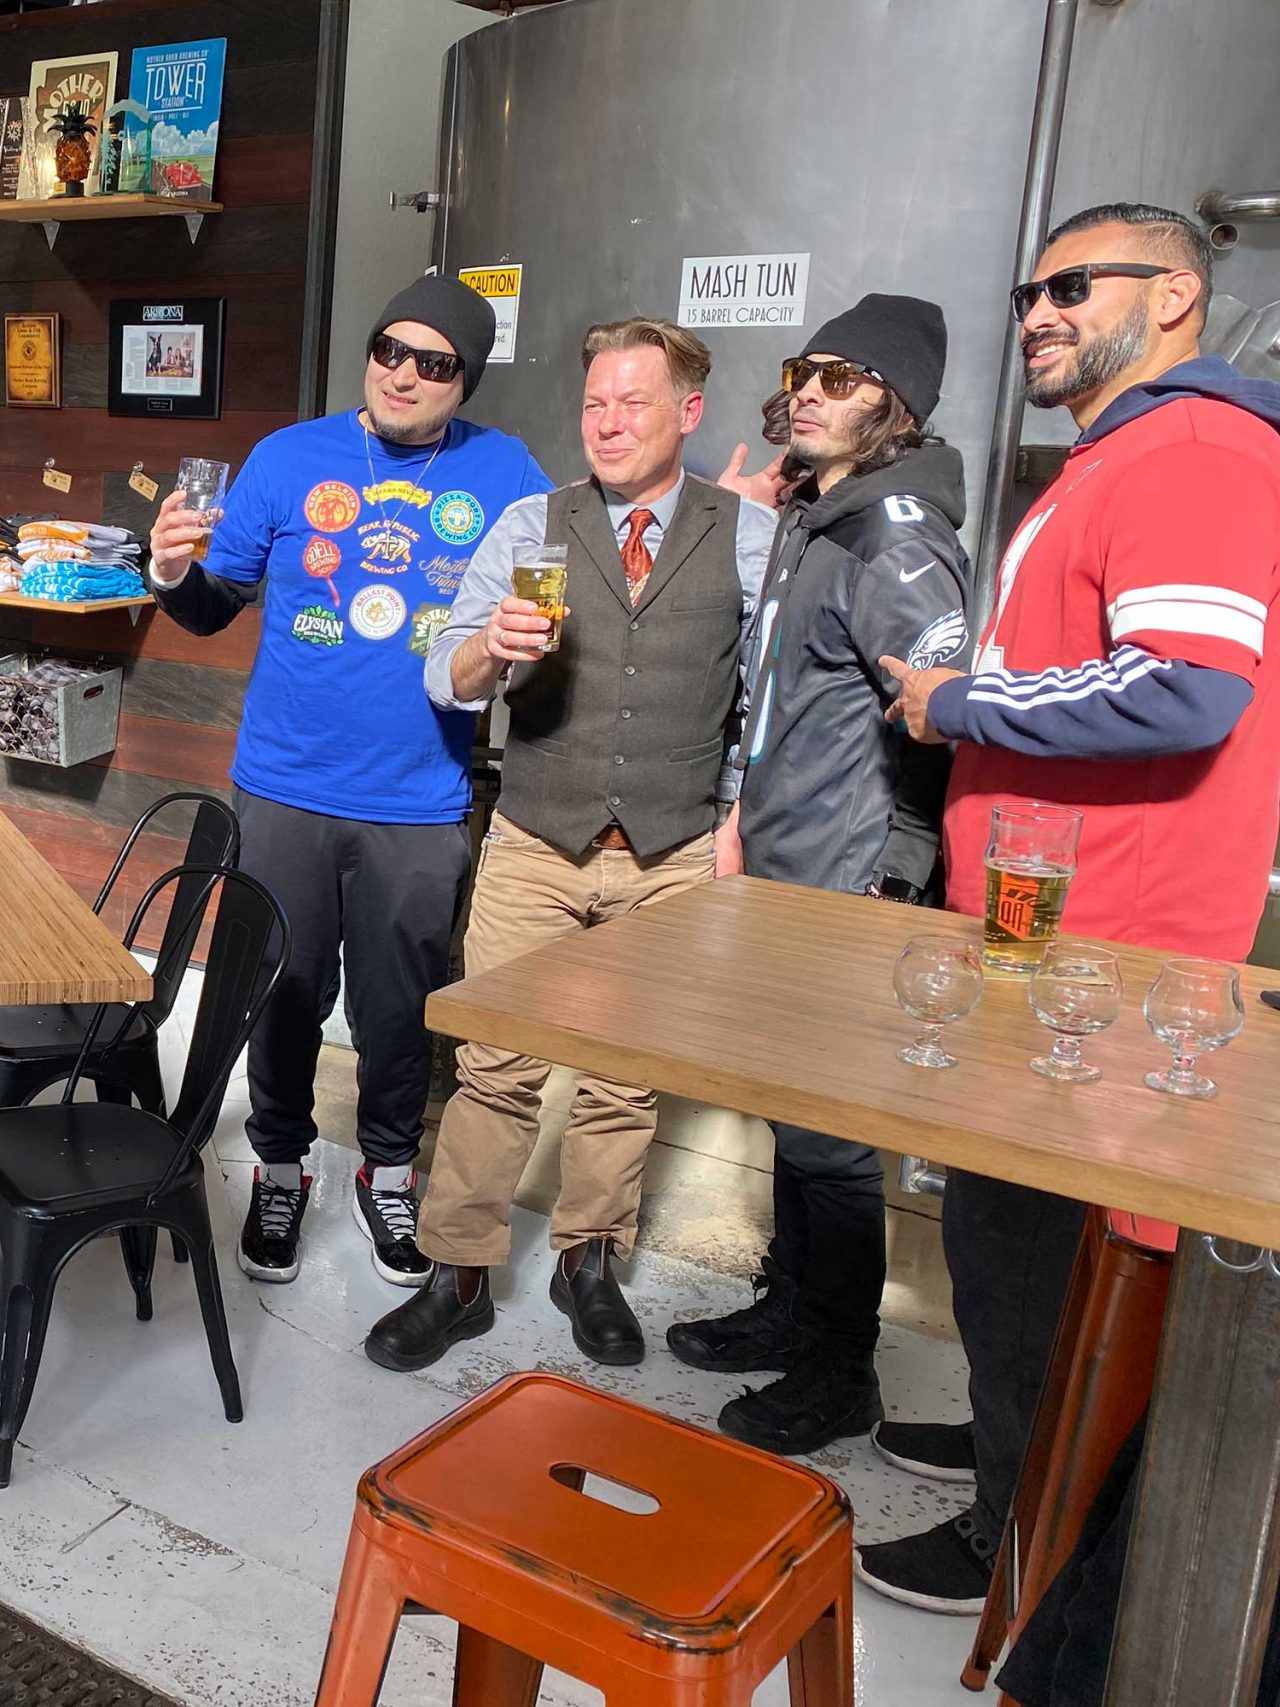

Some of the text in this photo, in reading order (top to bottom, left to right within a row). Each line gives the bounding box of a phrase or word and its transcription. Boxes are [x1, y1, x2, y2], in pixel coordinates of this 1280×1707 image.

[146, 62, 206, 110] TOWER
[43, 73, 103, 132] MOTHER
[161, 96, 185, 108] STATION
[469, 273, 516, 293] CAUTION
[690, 262, 797, 298] MASH TUN
[144, 305, 181, 317] ARIZONA
[687, 306, 795, 323] 15 BARREL CAPACITY
[308, 484, 356, 508] NEW BELGIUM
[436, 495, 481, 518] PIZZA PORT
[358, 520, 382, 535] BEAR
[434, 518, 478, 541] BREWING CO
[307, 542, 336, 565] ODELL
[310, 556, 337, 571] BREWING
[360, 561, 408, 574] BREWING CO
[355, 589, 401, 611] BALLAST POINT
[293, 613, 344, 640] ELYSIAN
[416, 609, 451, 637] MOTHE
